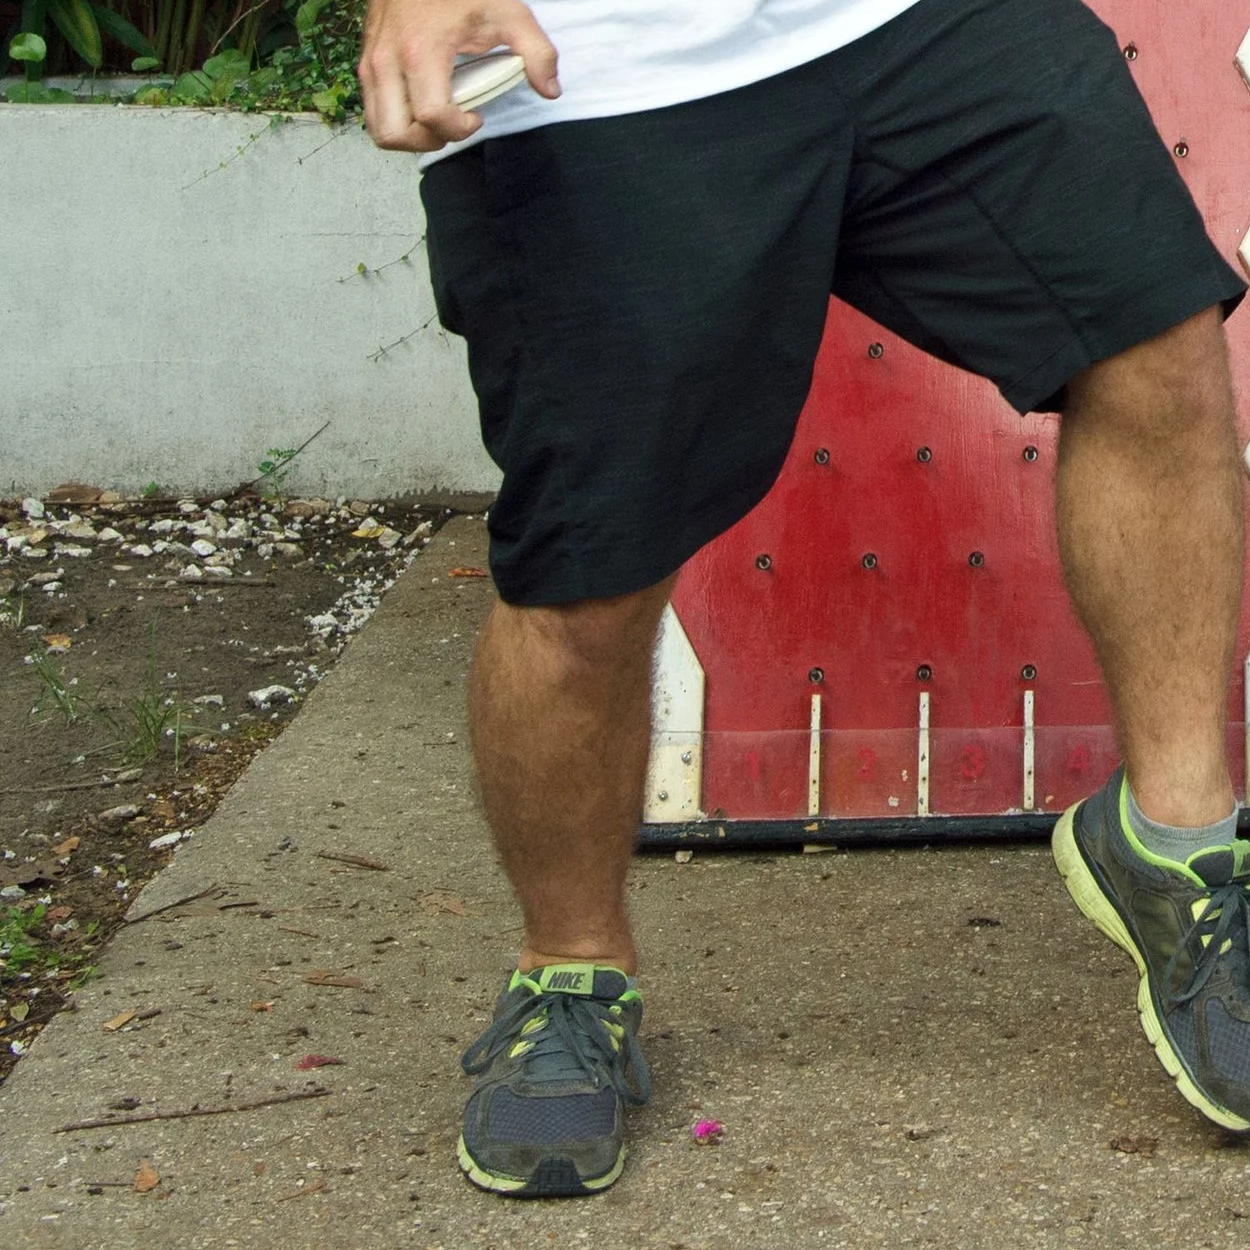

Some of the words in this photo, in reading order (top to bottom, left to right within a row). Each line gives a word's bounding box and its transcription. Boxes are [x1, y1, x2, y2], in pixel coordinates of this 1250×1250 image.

[856, 748, 877, 782] 2
[958, 746, 985, 779] 3
[547, 971, 585, 990] NIKE
